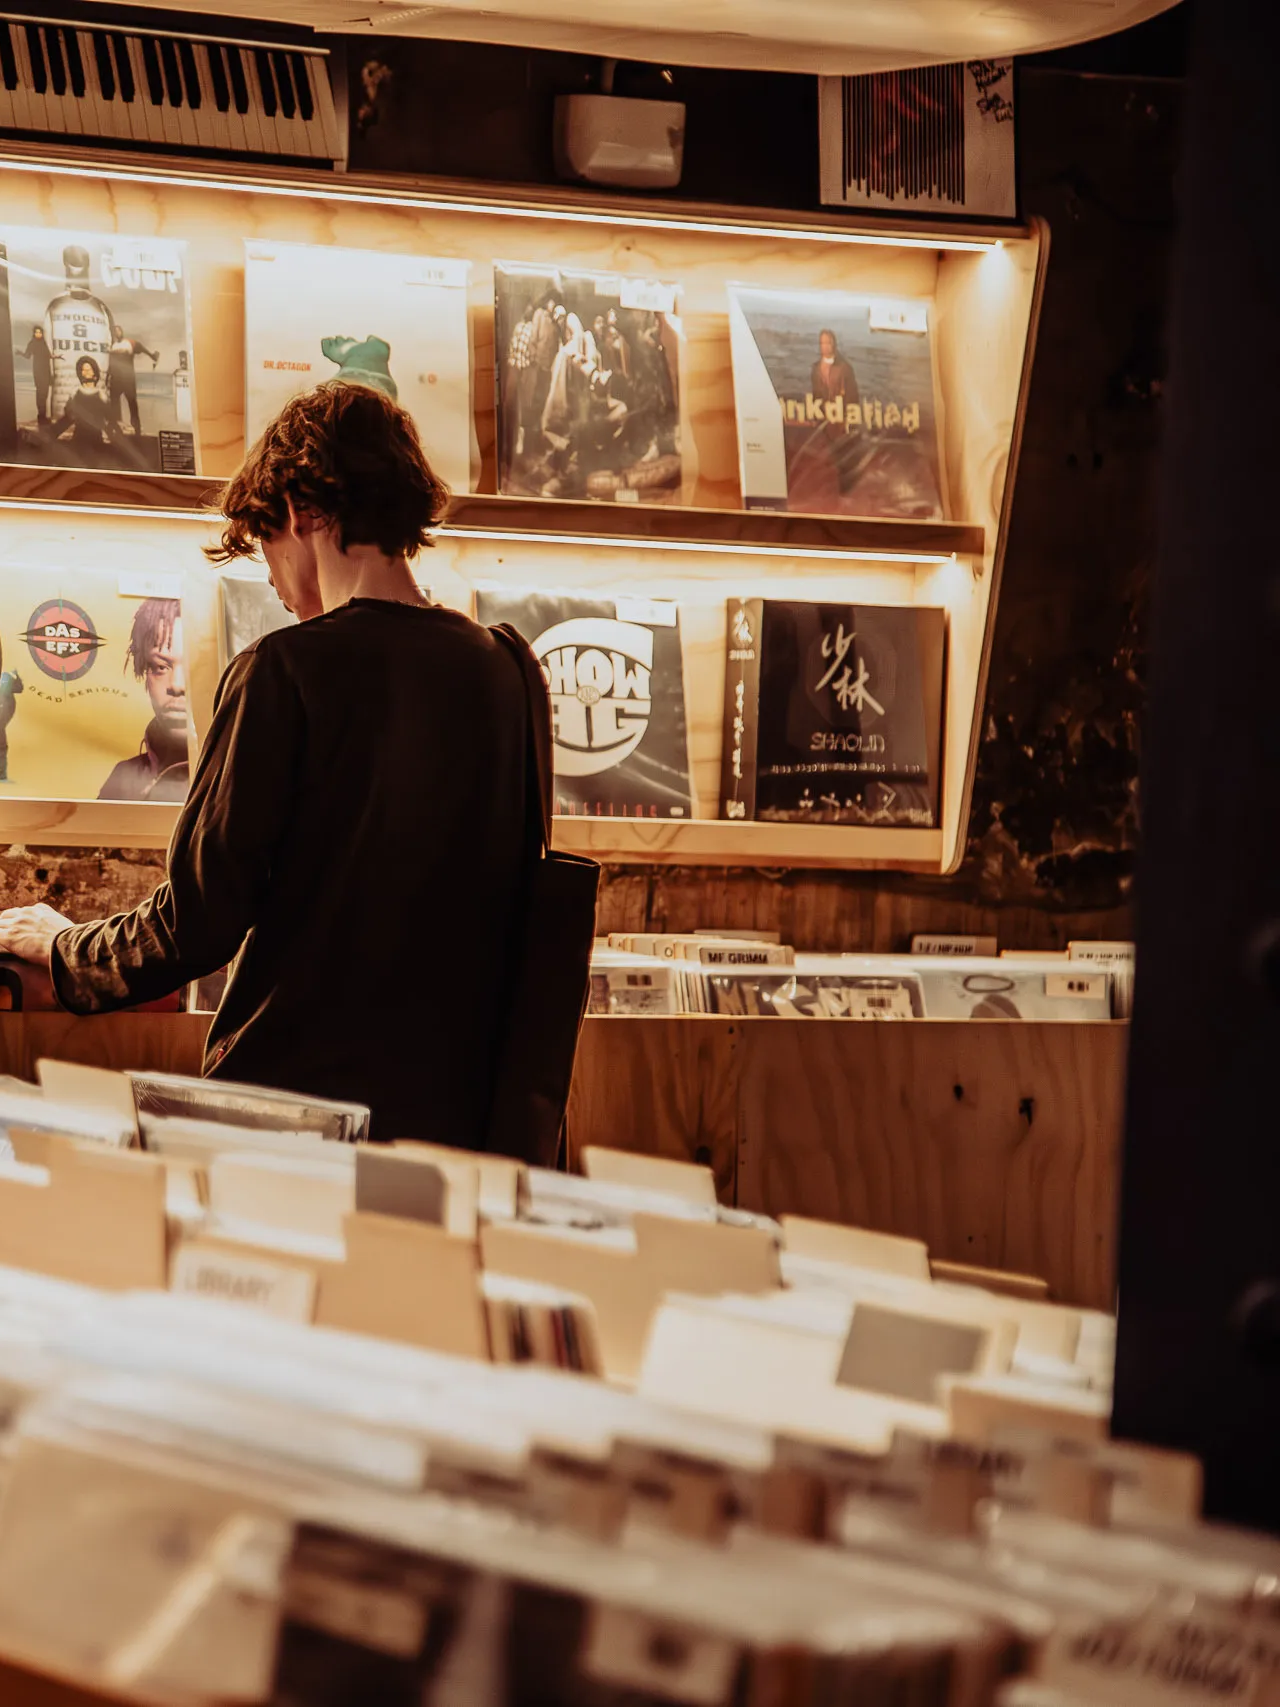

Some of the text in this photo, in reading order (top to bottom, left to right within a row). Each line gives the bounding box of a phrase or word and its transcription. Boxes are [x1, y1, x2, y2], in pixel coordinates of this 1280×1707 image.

[72, 324, 88, 338] &
[44, 623, 81, 639] DAS
[46, 640, 81, 655] EFX
[542, 645, 652, 700] HOW
[29, 685, 129, 703] DEAD SERIOUS
